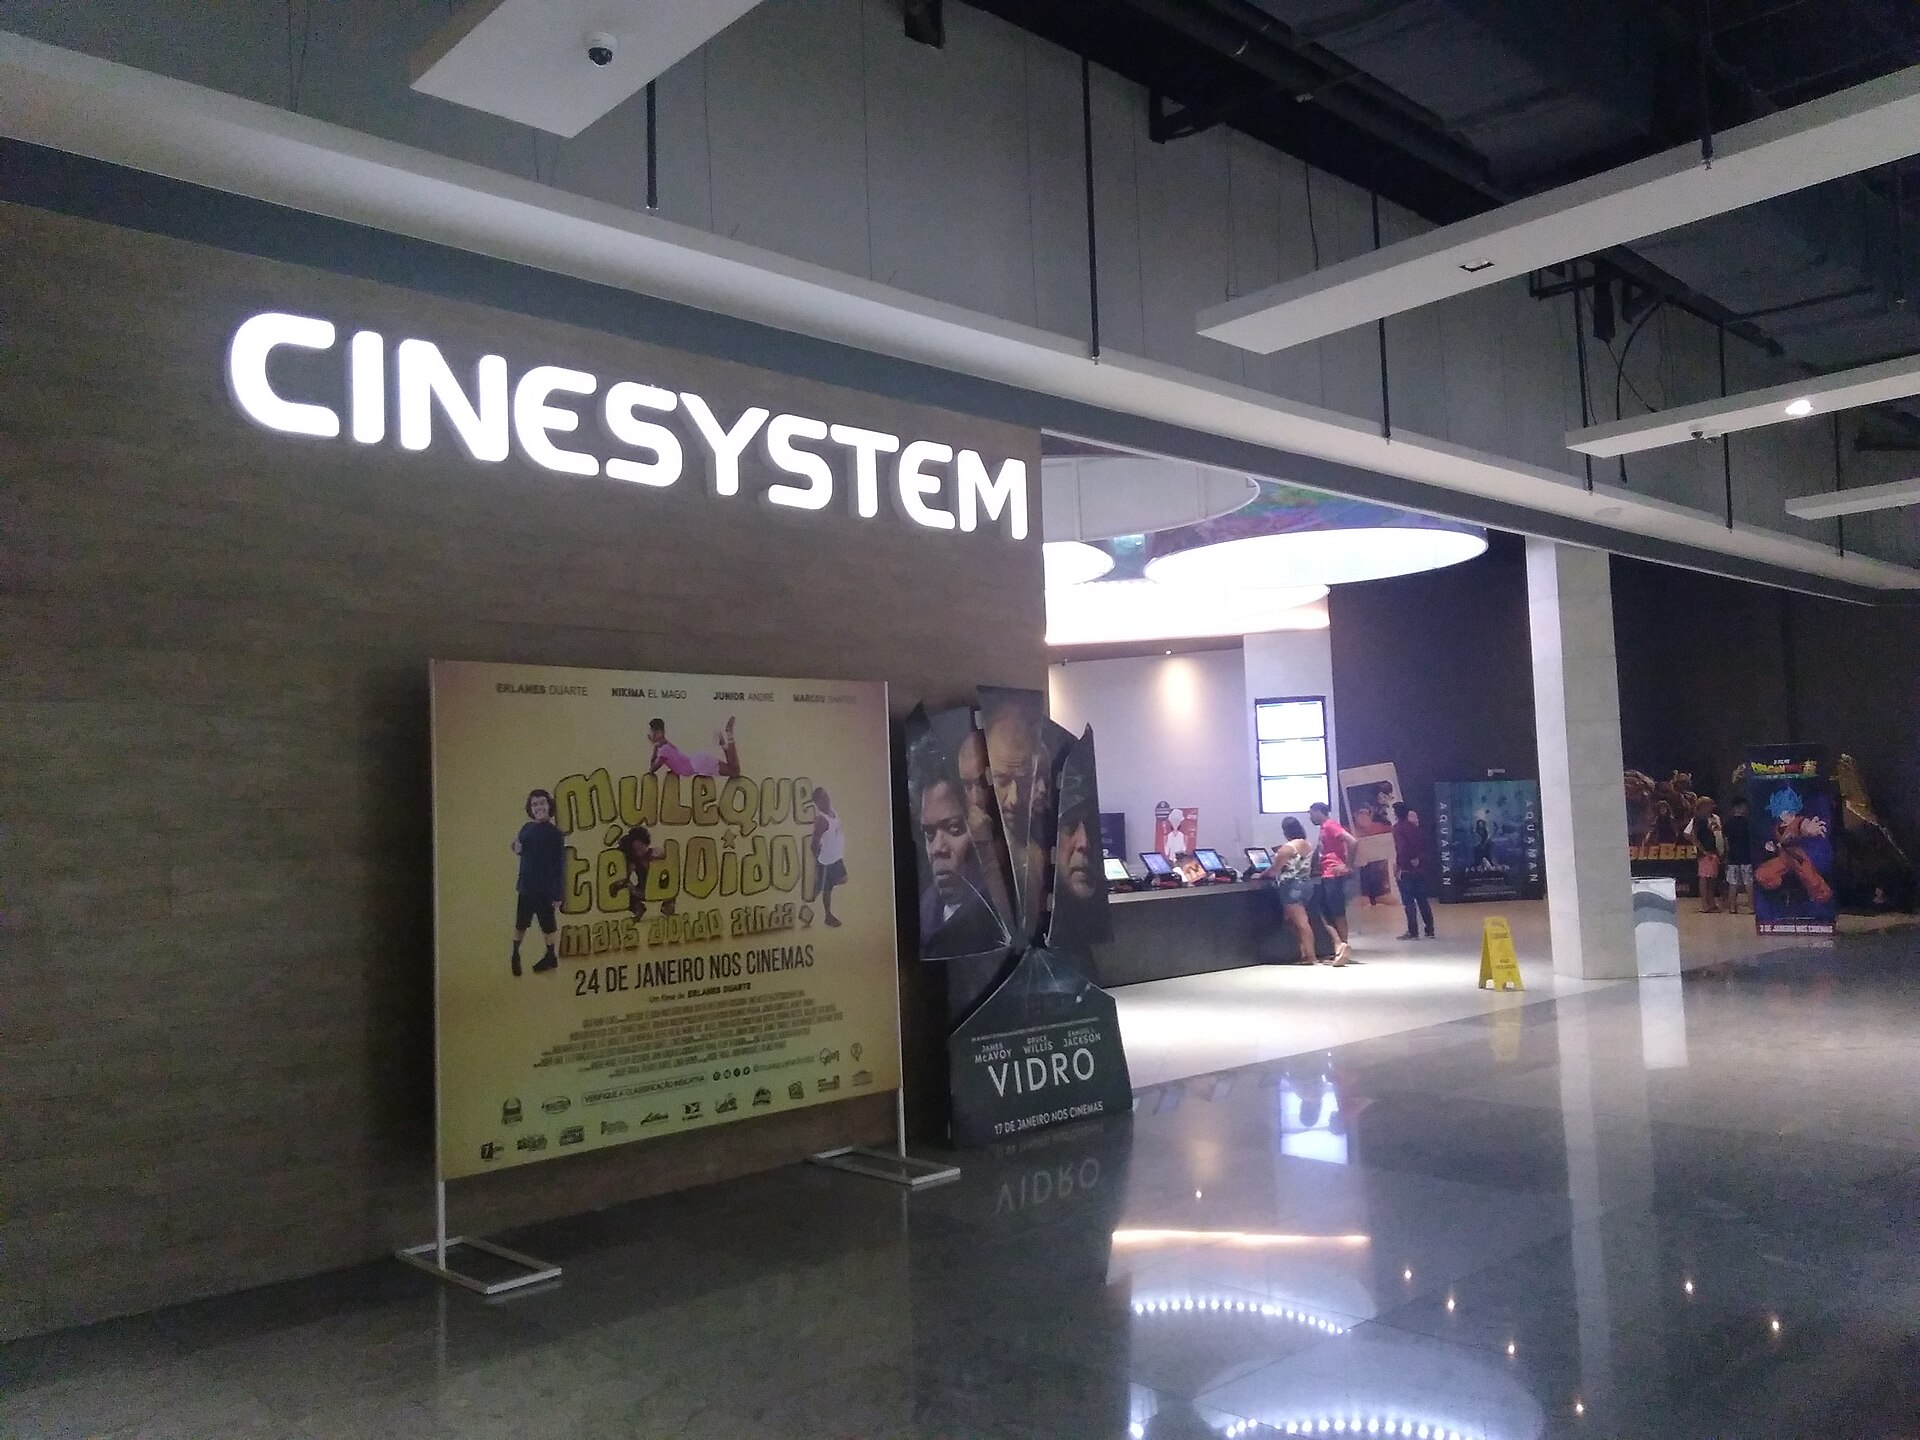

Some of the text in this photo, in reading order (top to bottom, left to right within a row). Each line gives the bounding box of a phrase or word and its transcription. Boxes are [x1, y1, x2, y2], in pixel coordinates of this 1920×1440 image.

[229, 312, 1029, 541] CINESYSTEM
[550, 685, 589, 696] DUARTE
[611, 688, 688, 700] NIKIMA EL MAGO
[713, 691, 746, 701] JUNIOR
[1439, 802, 1452, 886] AQUAMAN
[1525, 800, 1539, 883] AQUAMAN
[575, 943, 815, 997] 24 DE JANEIRO NOS CINEMAS
[1027, 1034, 1048, 1045] BRUCE
[1063, 1032, 1101, 1048] JACKSON
[974, 1048, 1012, 1064] McAVOY
[1023, 1041, 1054, 1055] WILLIS
[987, 1048, 1095, 1097] VIDRO
[994, 1100, 1104, 1135] 17 DE JANEIRO NOS CINEMAS
